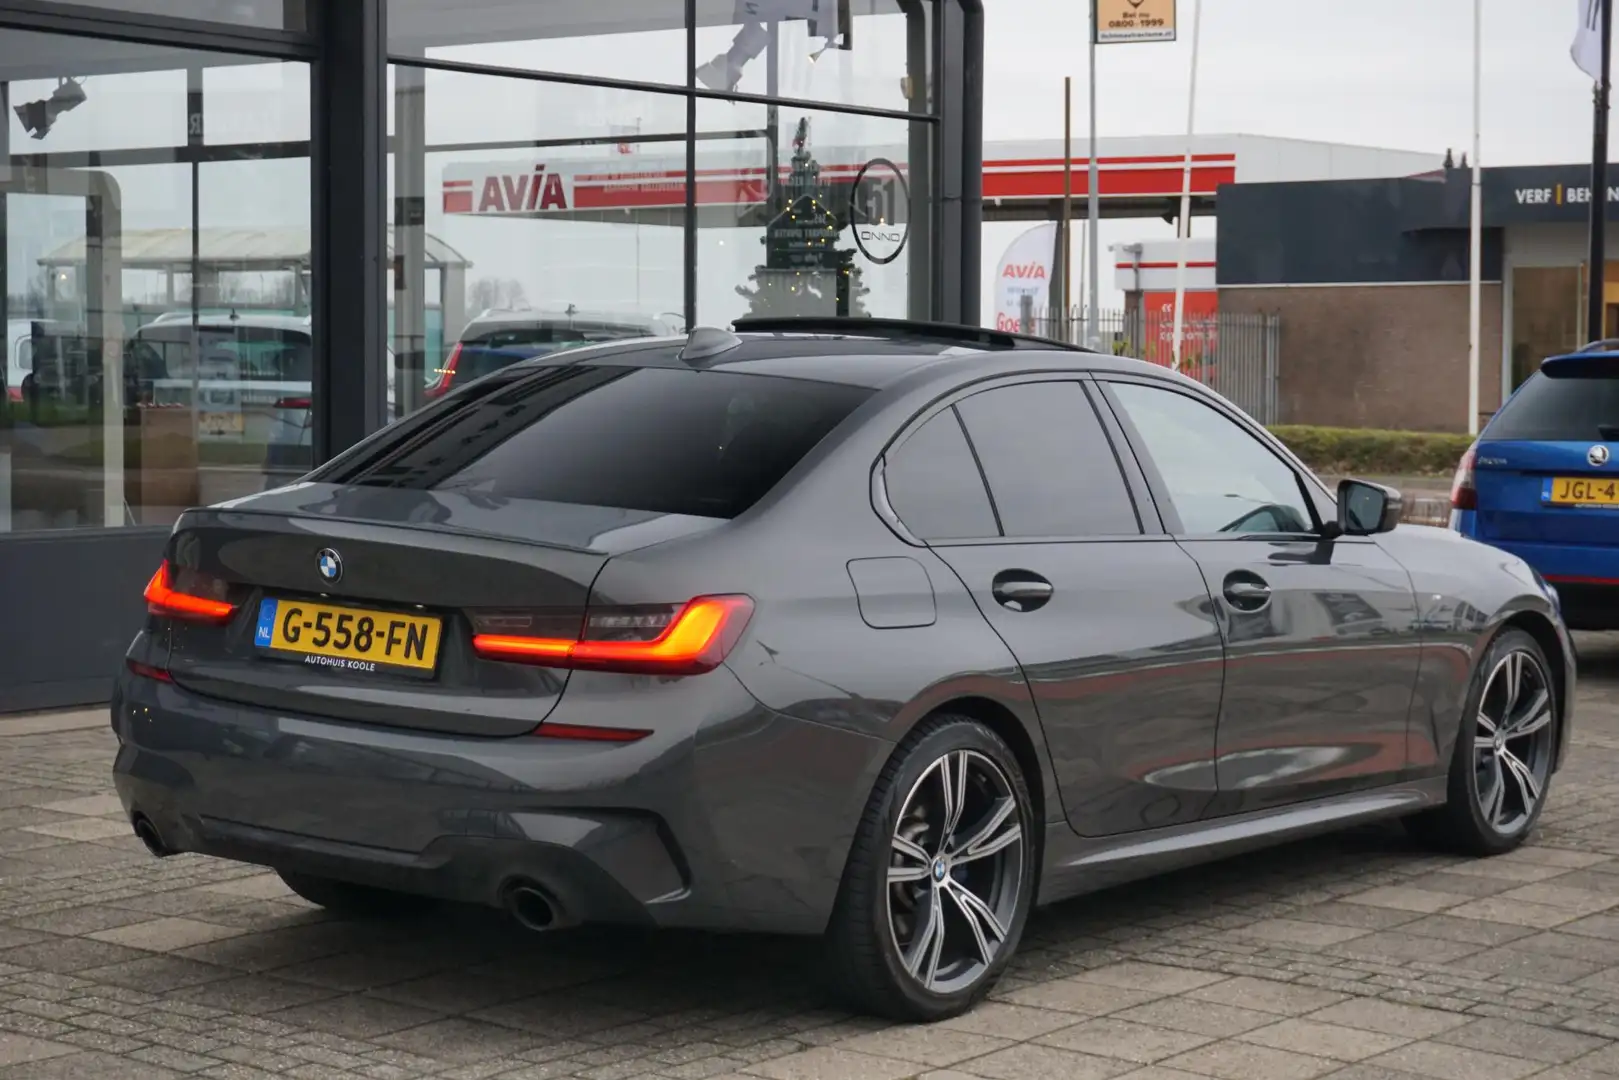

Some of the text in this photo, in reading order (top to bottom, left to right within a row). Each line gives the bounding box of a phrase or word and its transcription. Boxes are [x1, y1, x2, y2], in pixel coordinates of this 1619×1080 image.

[866, 177, 895, 227] 51
[1515, 188, 1552, 204] VERF
[861, 231, 900, 242] ONNO
[1560, 481, 1619, 500] JGL-4
[258, 626, 270, 638] NL
[283, 608, 428, 661] G-558-FN
[305, 655, 375, 672] AUTOHUIS KOOLE
